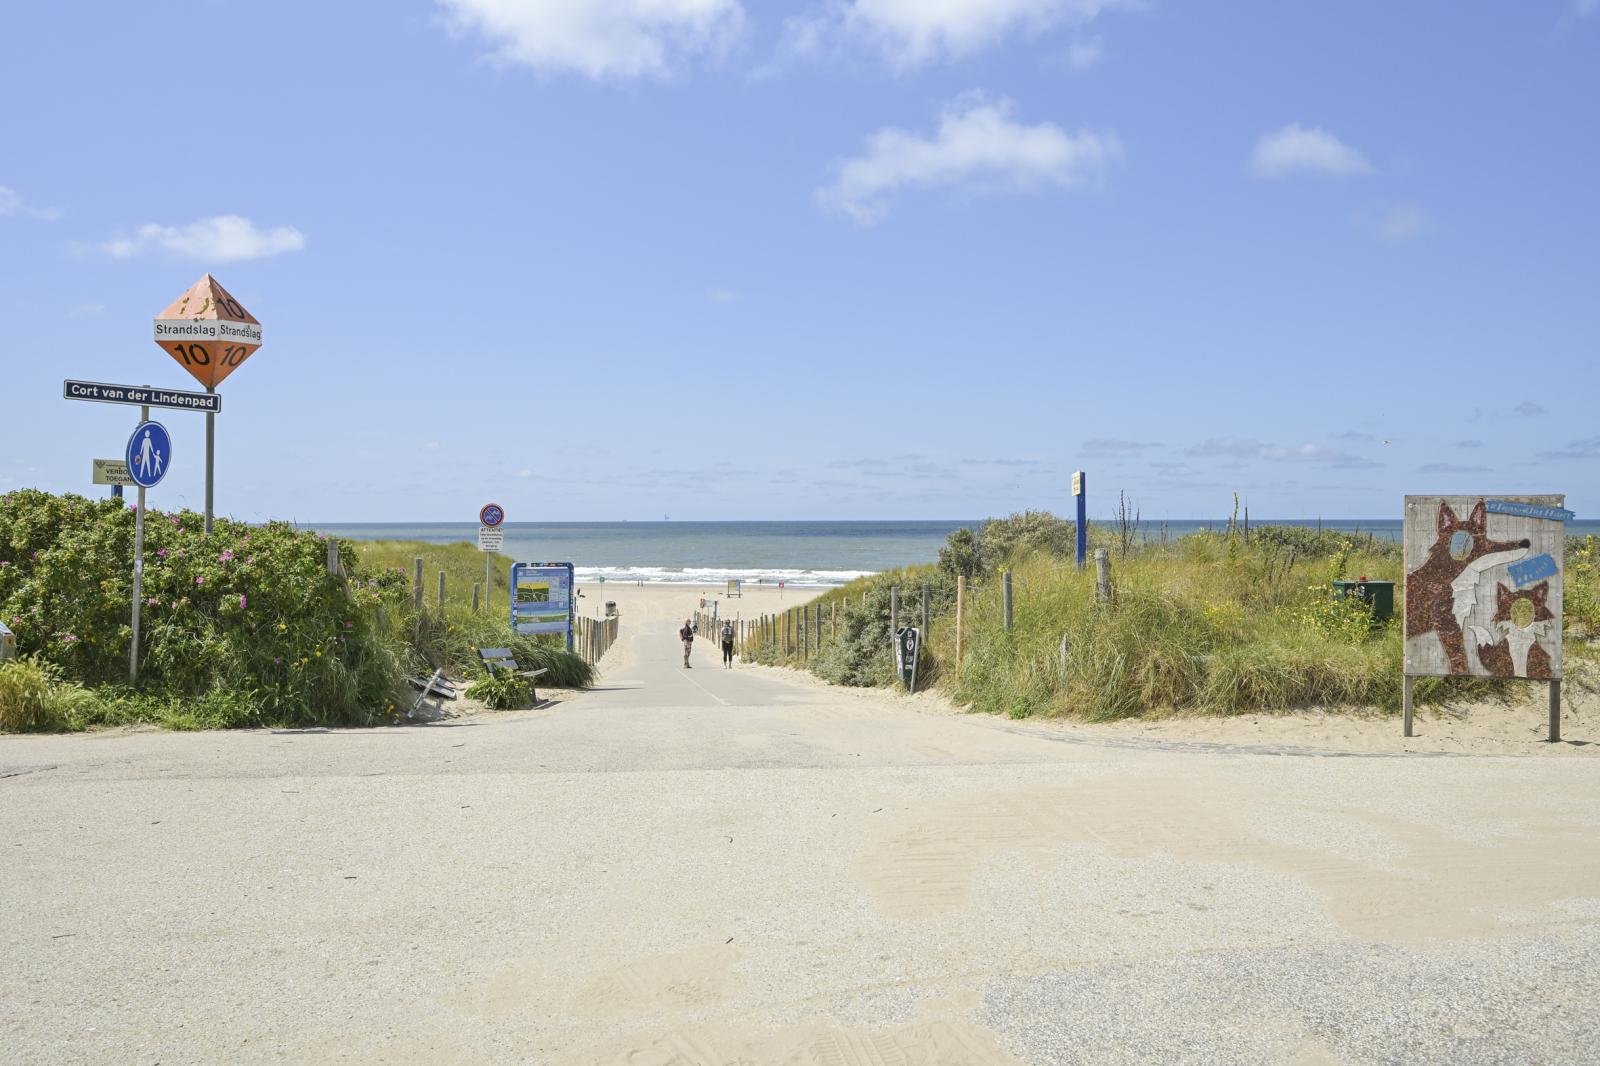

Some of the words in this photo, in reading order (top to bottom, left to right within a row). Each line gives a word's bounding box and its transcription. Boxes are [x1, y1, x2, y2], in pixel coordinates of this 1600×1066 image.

[217, 298, 245, 319] 10
[156, 324, 216, 336] Strandslag
[220, 324, 261, 341] Strandslag
[174, 343, 210, 365] 10
[220, 344, 247, 367] 10
[71, 384, 99, 397] Cort
[102, 390, 124, 399] van
[127, 390, 148, 401] der
[151, 391, 214, 408] Lindenpad
